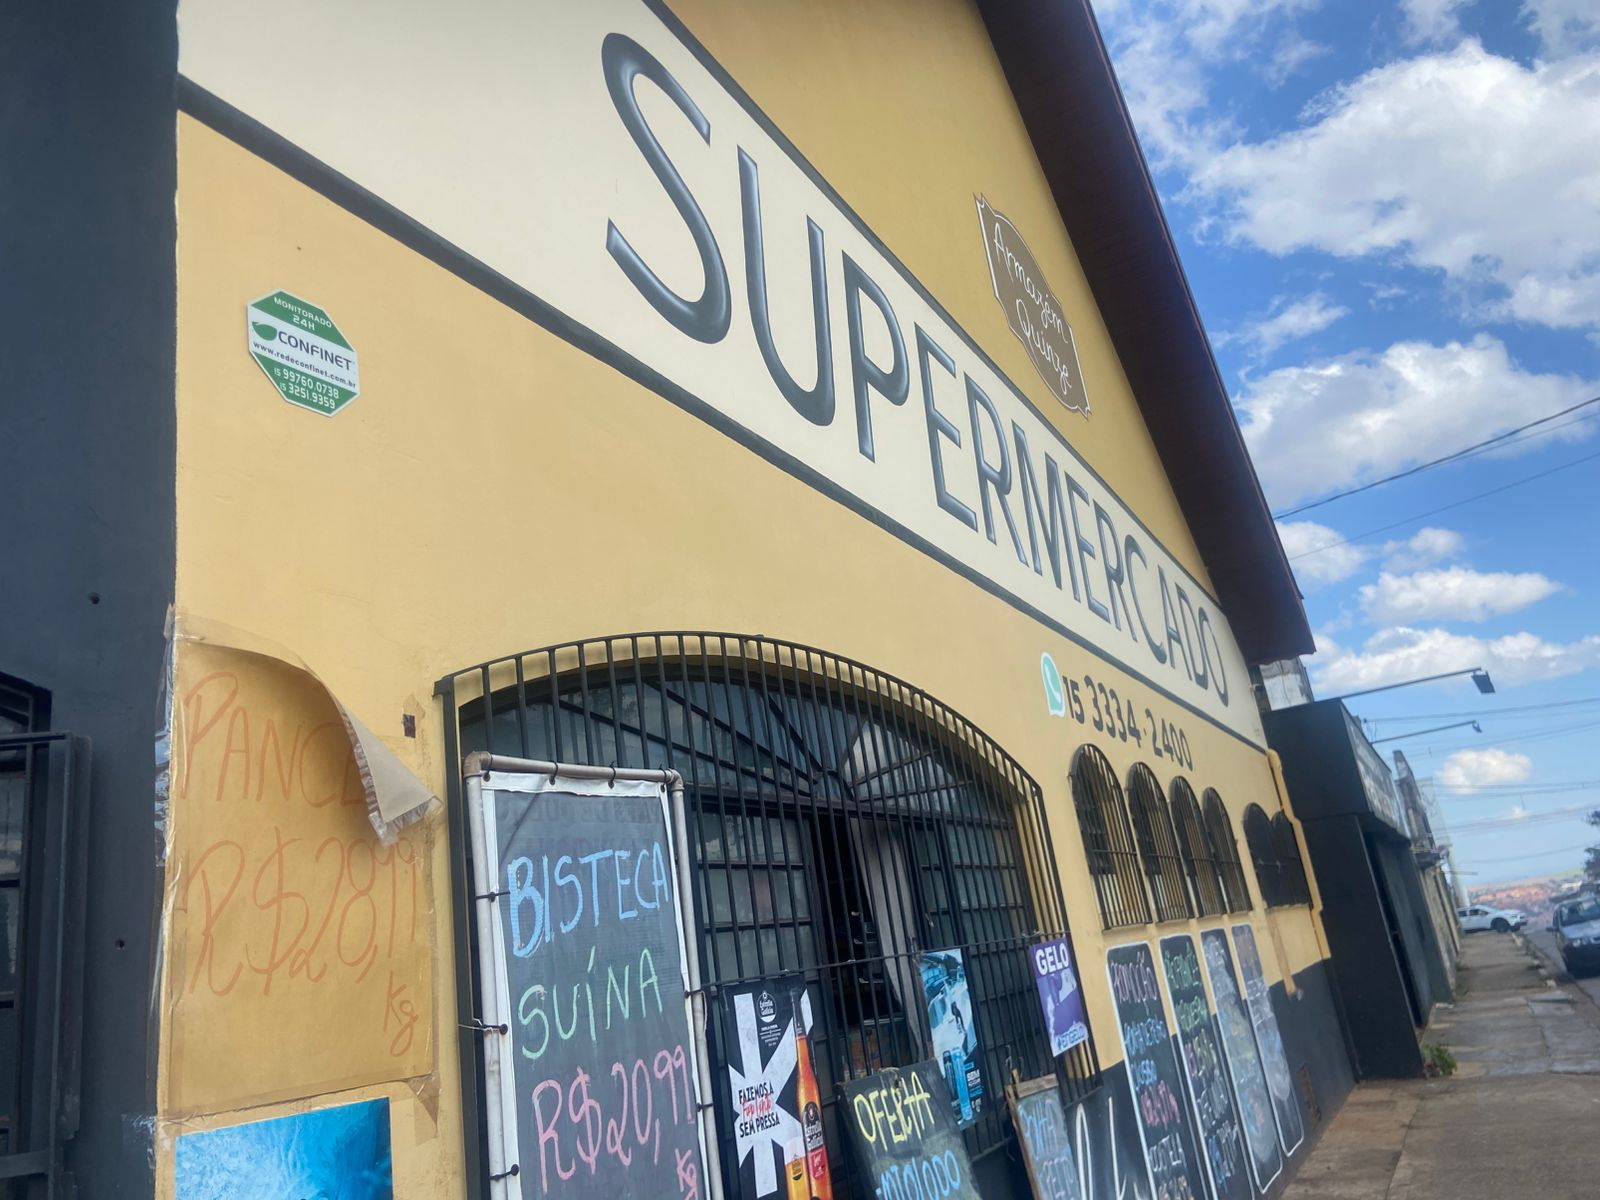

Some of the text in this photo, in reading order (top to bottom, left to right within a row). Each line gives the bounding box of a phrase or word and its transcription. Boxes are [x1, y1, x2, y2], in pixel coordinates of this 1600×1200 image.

[273, 296, 332, 328] MONITORADO
[292, 314, 315, 331] 24H
[252, 341, 356, 388] www.redeconfinet.com.br
[278, 330, 352, 371] CONFINET
[601, 32, 1230, 708] SUPERMERCADO
[1015, 298, 1073, 395] Quinze
[1062, 675, 1085, 725] 15
[506, 841, 670, 959] BISTECA
[1035, 942, 1070, 977] GELO
[517, 944, 664, 1060] SUÍNA
[739, 1081, 775, 1104] FAZEMOS A
[852, 1070, 936, 1152] OFERTA
[531, 1044, 696, 1195] R$20,99
[739, 1111, 781, 1138] SEM PRESSA
